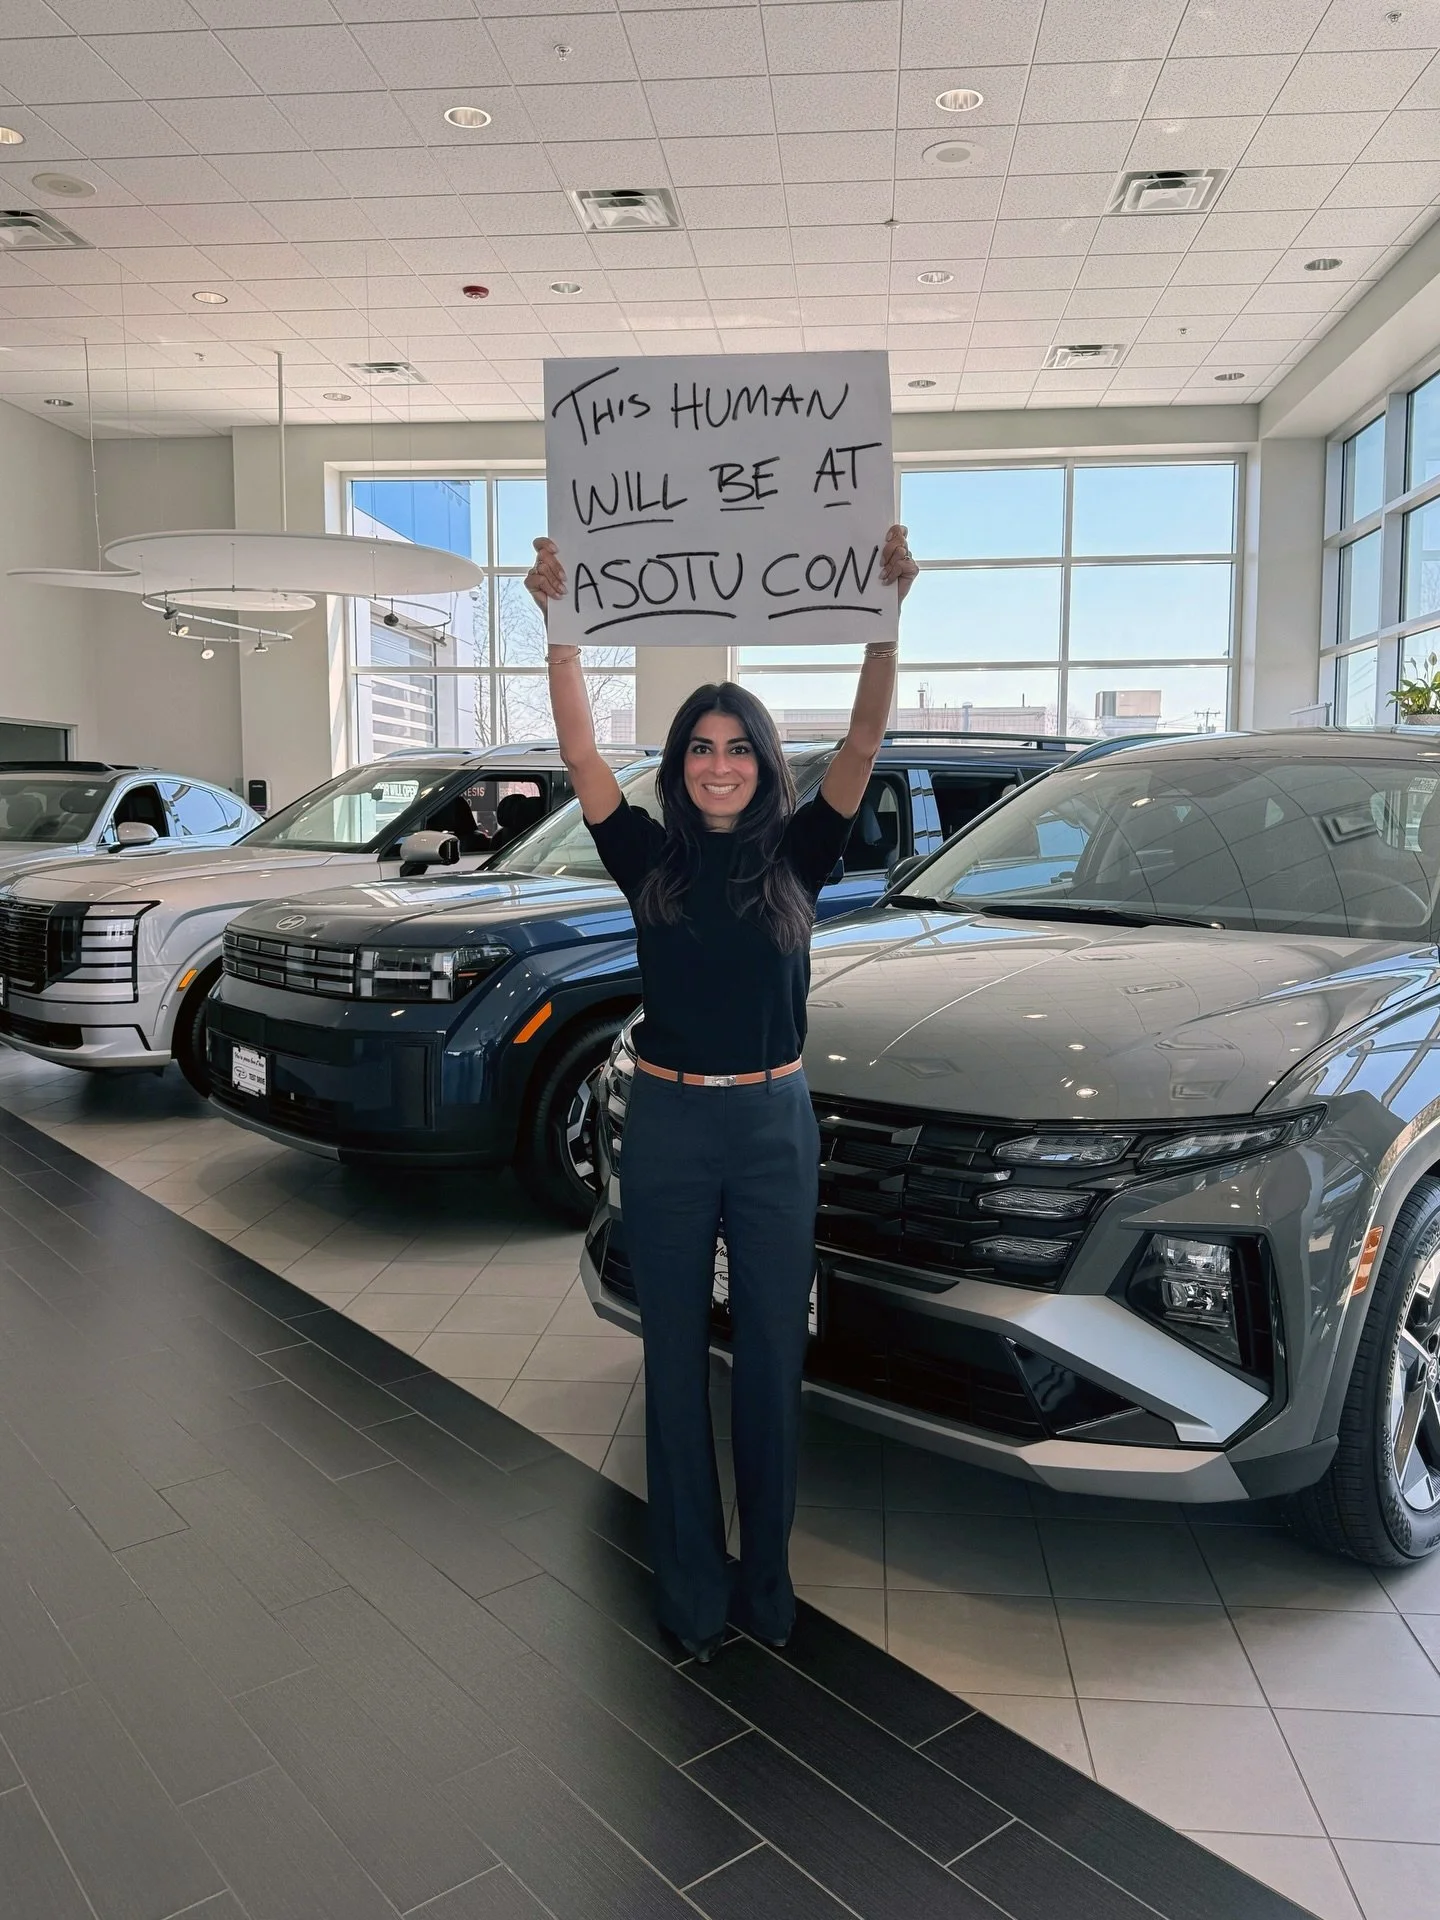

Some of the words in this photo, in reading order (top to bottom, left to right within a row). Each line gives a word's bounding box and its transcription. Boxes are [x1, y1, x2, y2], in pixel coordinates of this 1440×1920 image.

[671, 382, 849, 430] HUMAN
[572, 471, 688, 526] WILL
[708, 456, 780, 504] BE
[813, 443, 883, 494] AT
[574, 551, 744, 614] ASOTU
[761, 545, 880, 601] CON
[461, 786, 485, 798] NESIS
